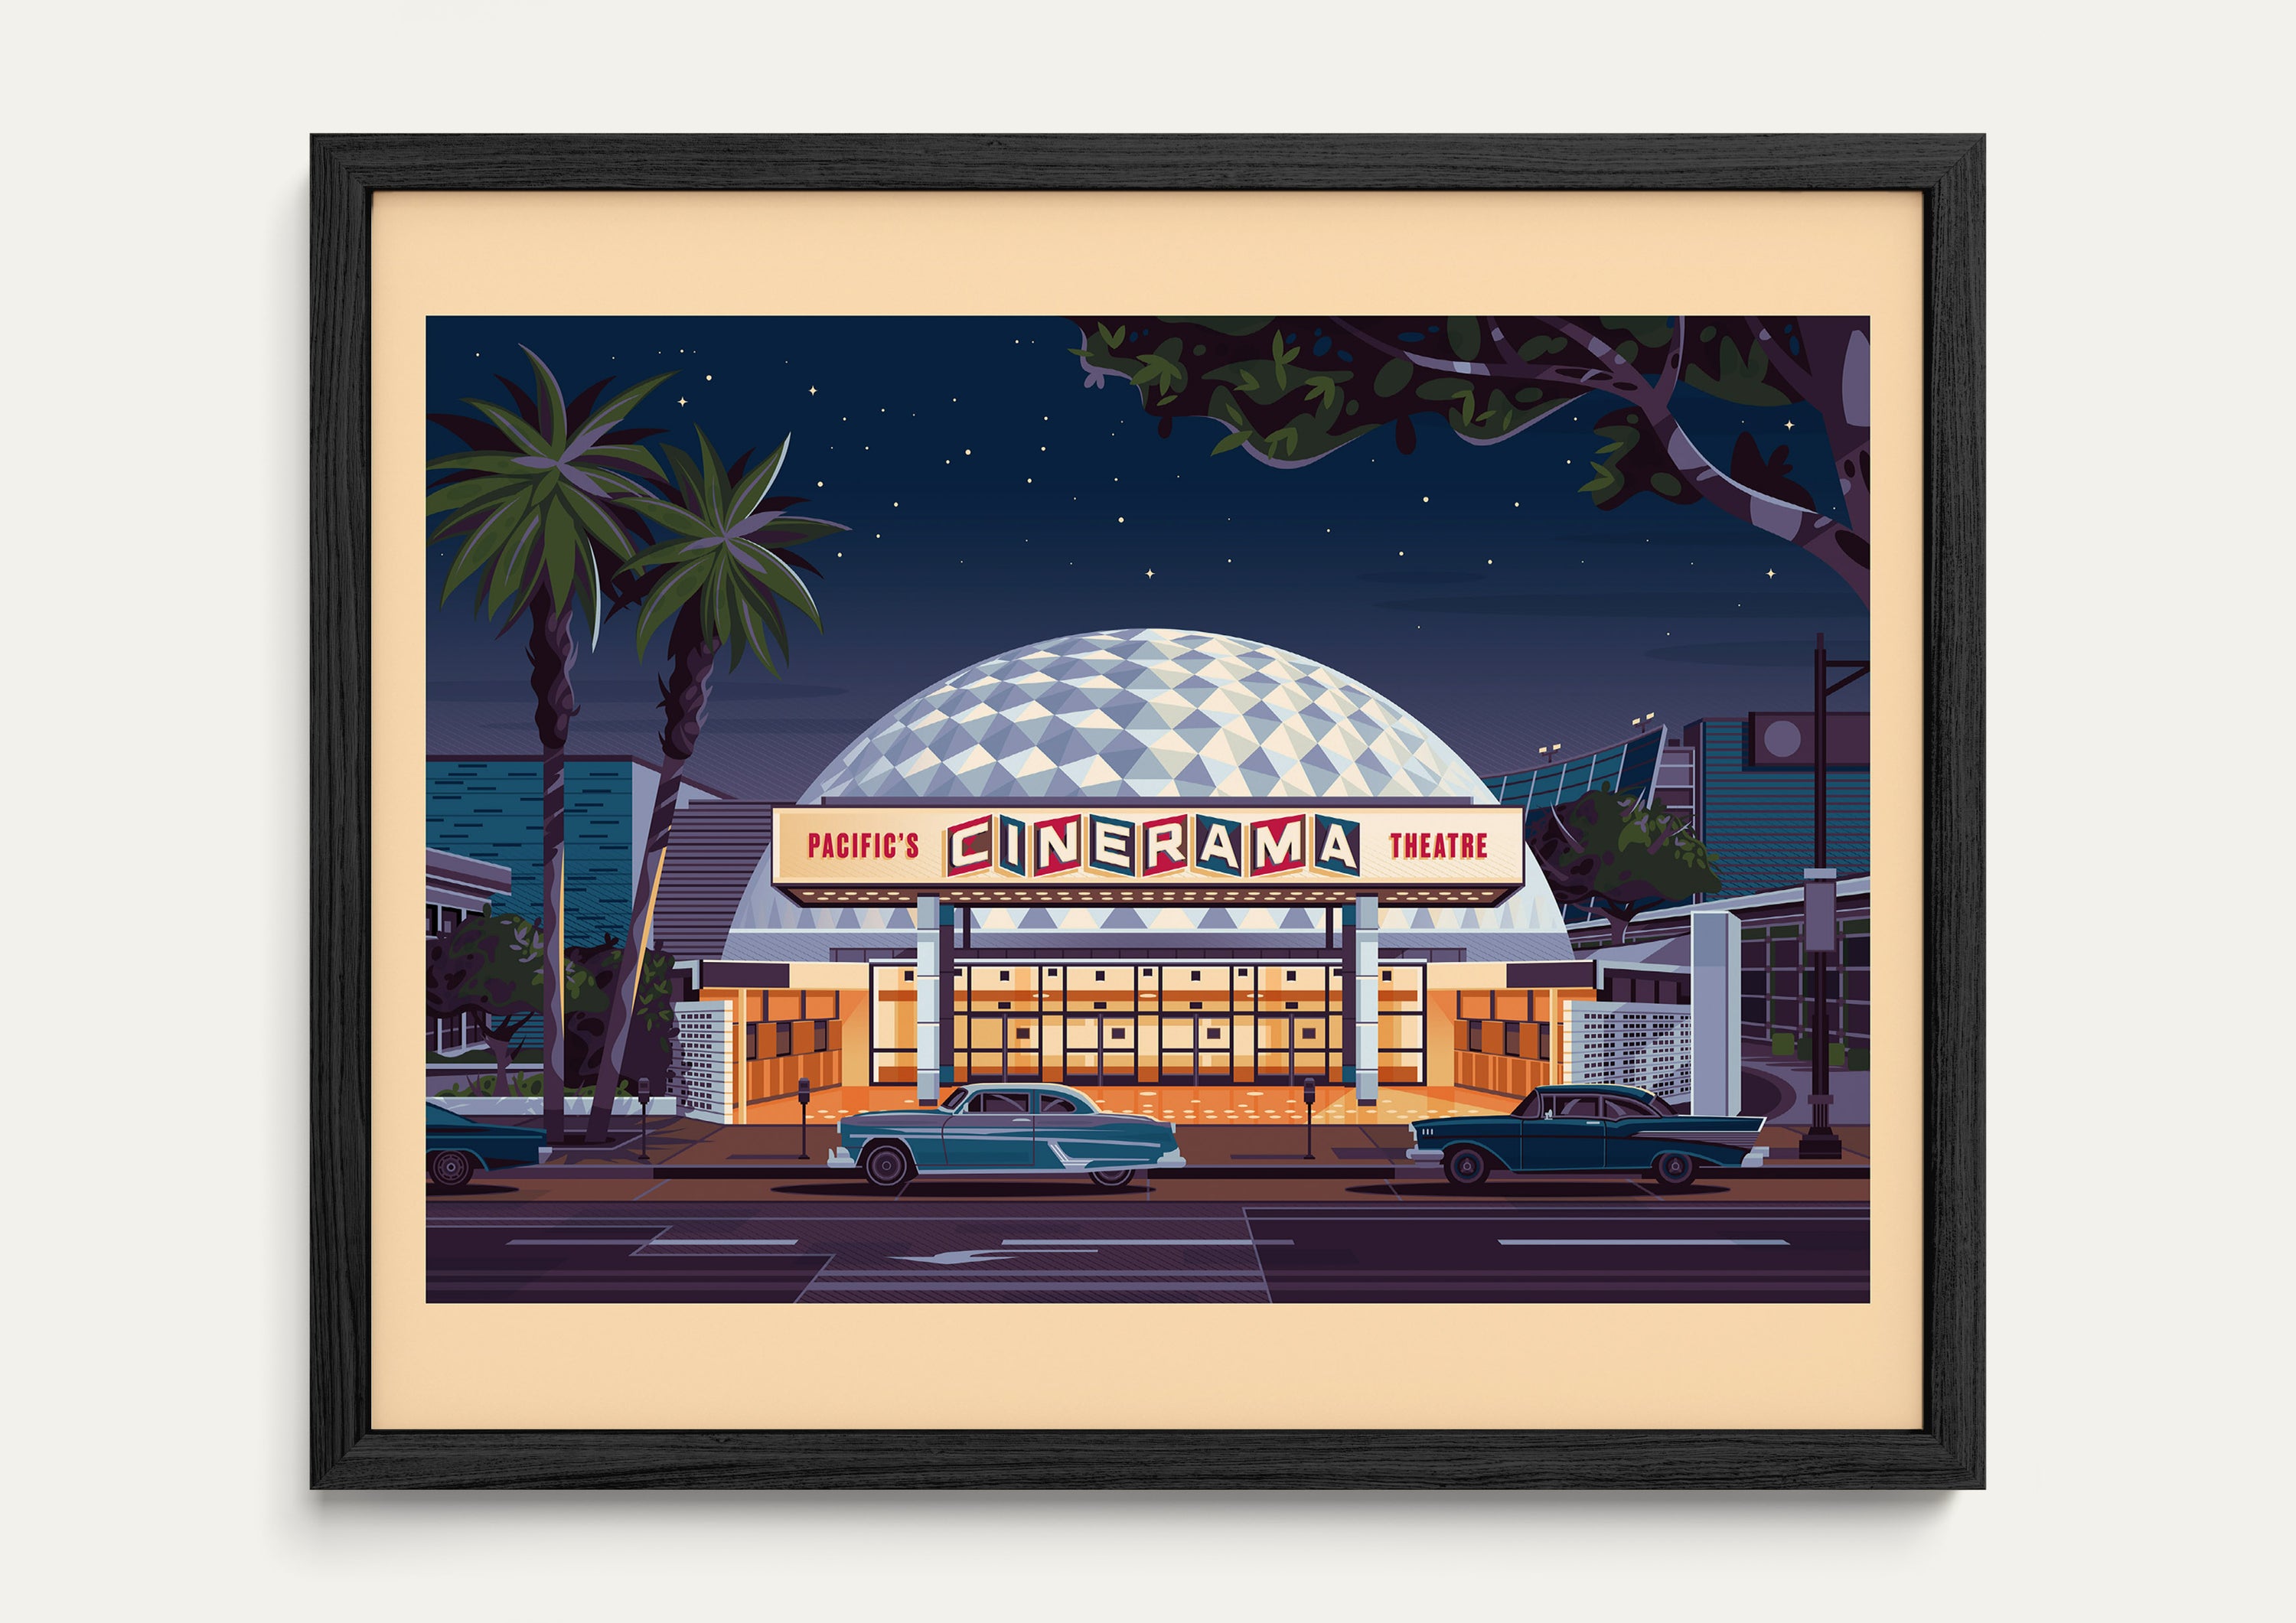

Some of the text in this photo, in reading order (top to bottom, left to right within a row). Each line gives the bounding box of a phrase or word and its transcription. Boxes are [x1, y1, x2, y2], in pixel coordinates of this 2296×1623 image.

[808, 820, 1487, 869] PACIFIC’S CINERAMA THEATRE
